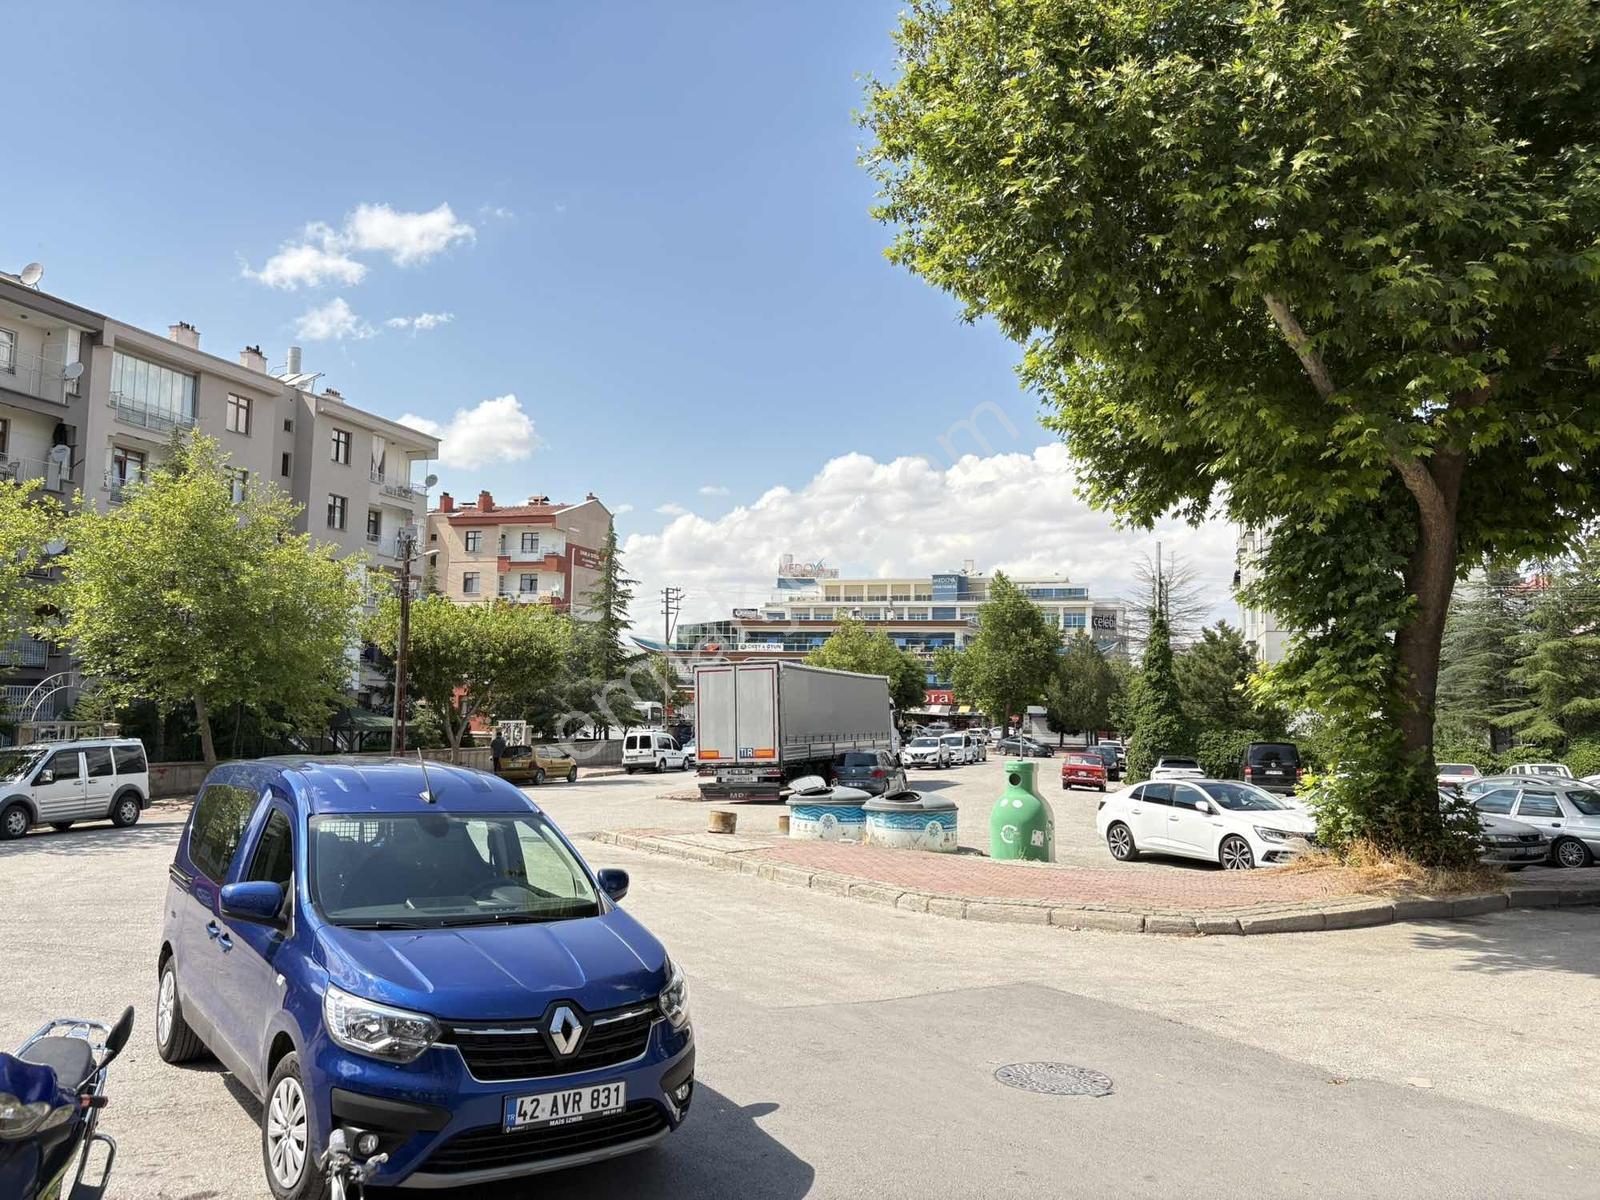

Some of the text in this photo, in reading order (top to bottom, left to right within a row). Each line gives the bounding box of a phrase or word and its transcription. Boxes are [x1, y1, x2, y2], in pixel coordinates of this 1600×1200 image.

[740, 748, 753, 757] TIR
[518, 1098, 540, 1121] 42
[550, 1092, 582, 1117] AVR
[590, 1085, 620, 1110] 831
